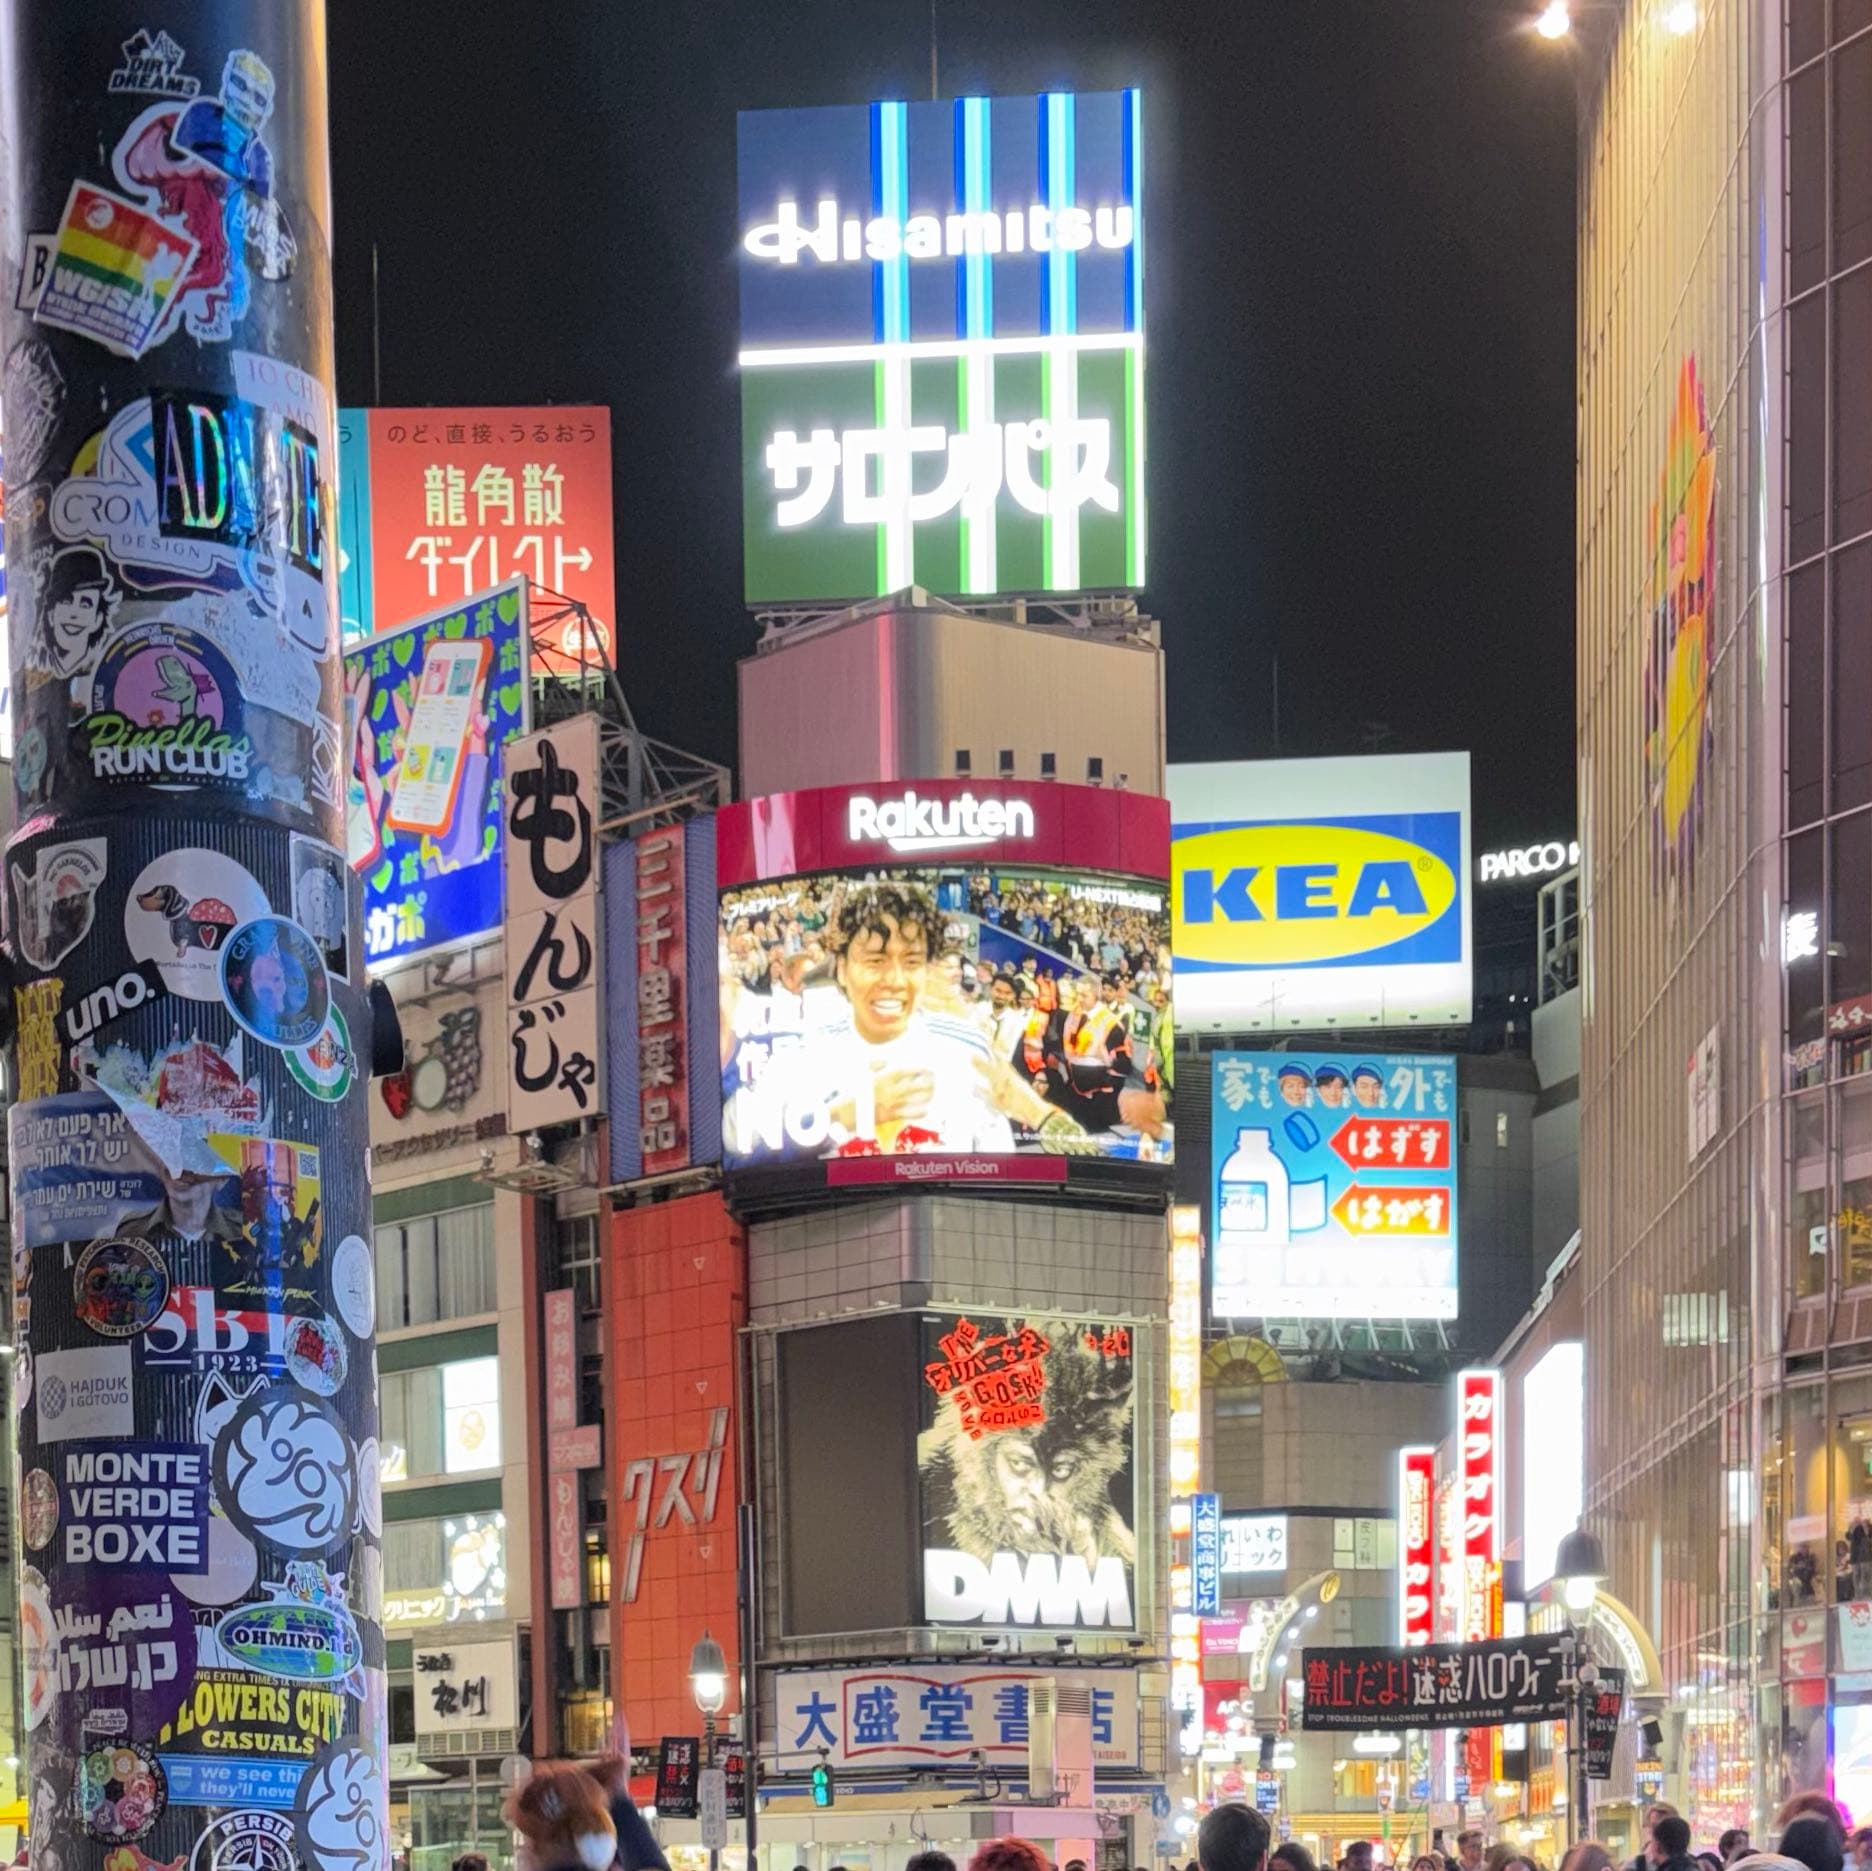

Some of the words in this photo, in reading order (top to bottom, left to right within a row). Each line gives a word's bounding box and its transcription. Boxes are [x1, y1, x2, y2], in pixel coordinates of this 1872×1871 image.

[744, 200, 1134, 263] Hisamitsu
[388, 424, 596, 444] のど、直接、うるおう
[766, 418, 1120, 528] サロンパス
[424, 464, 565, 526] 龍角散
[121, 533, 202, 561] DESIGN
[88, 713, 252, 760] Pinellas
[94, 742, 161, 778] RUN
[165, 743, 250, 781] CLUB
[849, 792, 1034, 842] Rakuten
[1480, 842, 1564, 882] PARCO
[1182, 861, 1428, 924] KEA
[511, 738, 596, 1108] もんじゃ
[66, 972, 155, 1041] uno.
[637, 838, 677, 1152] 三千里薬品
[1347, 1126, 1442, 1164] はずす
[895, 1161, 951, 1179] Rakuten
[957, 1161, 999, 1176] Vision
[1347, 1194, 1444, 1231] はがす
[198, 1353, 258, 1373] 1923
[70, 1376, 128, 1395] HAJDUK
[77, 1393, 128, 1408] GOTOVO
[66, 1453, 200, 1483] MONTE
[1465, 1393, 1493, 1540] カラオケ
[70, 1487, 195, 1517] VERDE
[66, 1525, 200, 1563] BOXE
[925, 1549, 1132, 1627] DMM
[54, 1604, 101, 1639] سلا
[61, 1644, 128, 1692] שלו
[213, 1671, 246, 1683] EXTRA
[249, 1673, 279, 1687] TIMES
[295, 1689, 345, 1744] CITY
[201, 1729, 315, 1755] CASUALS
[201, 1766, 231, 1781] we
[237, 1767, 273, 1782] see
[201, 1781, 253, 1800] they'll
[220, 1815, 293, 1842] PERSIB
